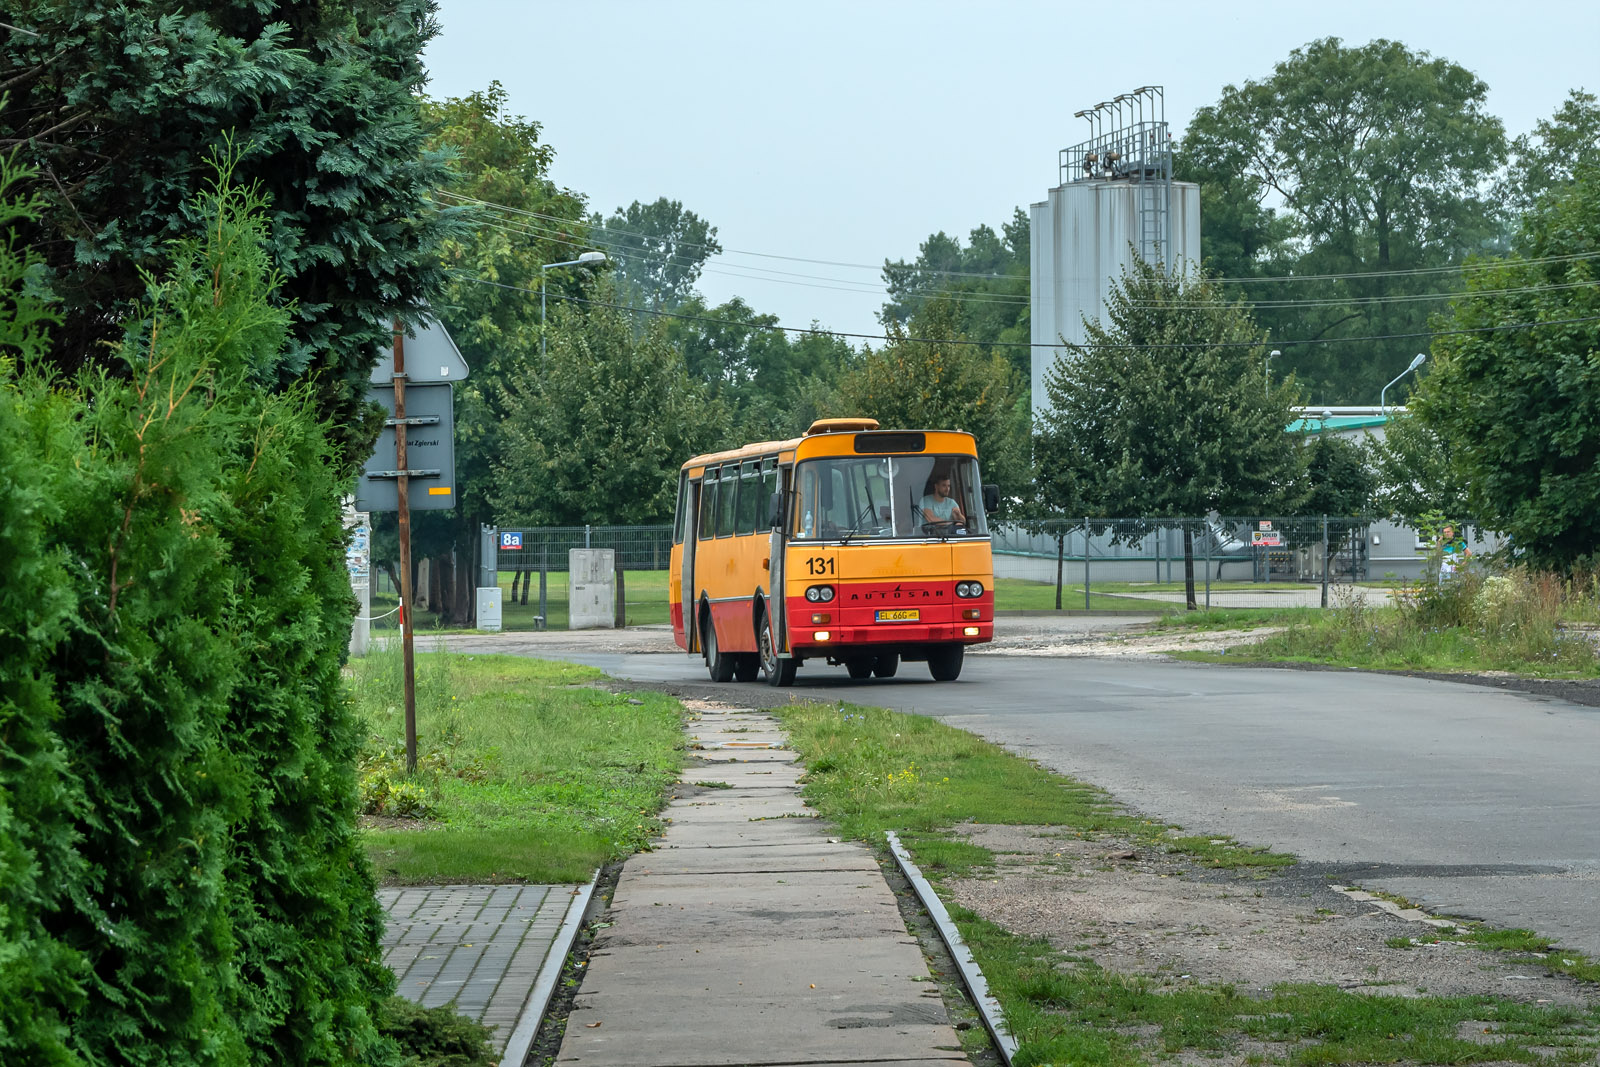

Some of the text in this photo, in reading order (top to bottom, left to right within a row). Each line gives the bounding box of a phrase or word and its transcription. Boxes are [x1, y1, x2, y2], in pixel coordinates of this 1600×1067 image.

[503, 533, 520, 545] 8a
[805, 557, 835, 575] 131
[851, 590, 944, 600] AUTOSAN
[880, 611, 907, 620] EL 66G
